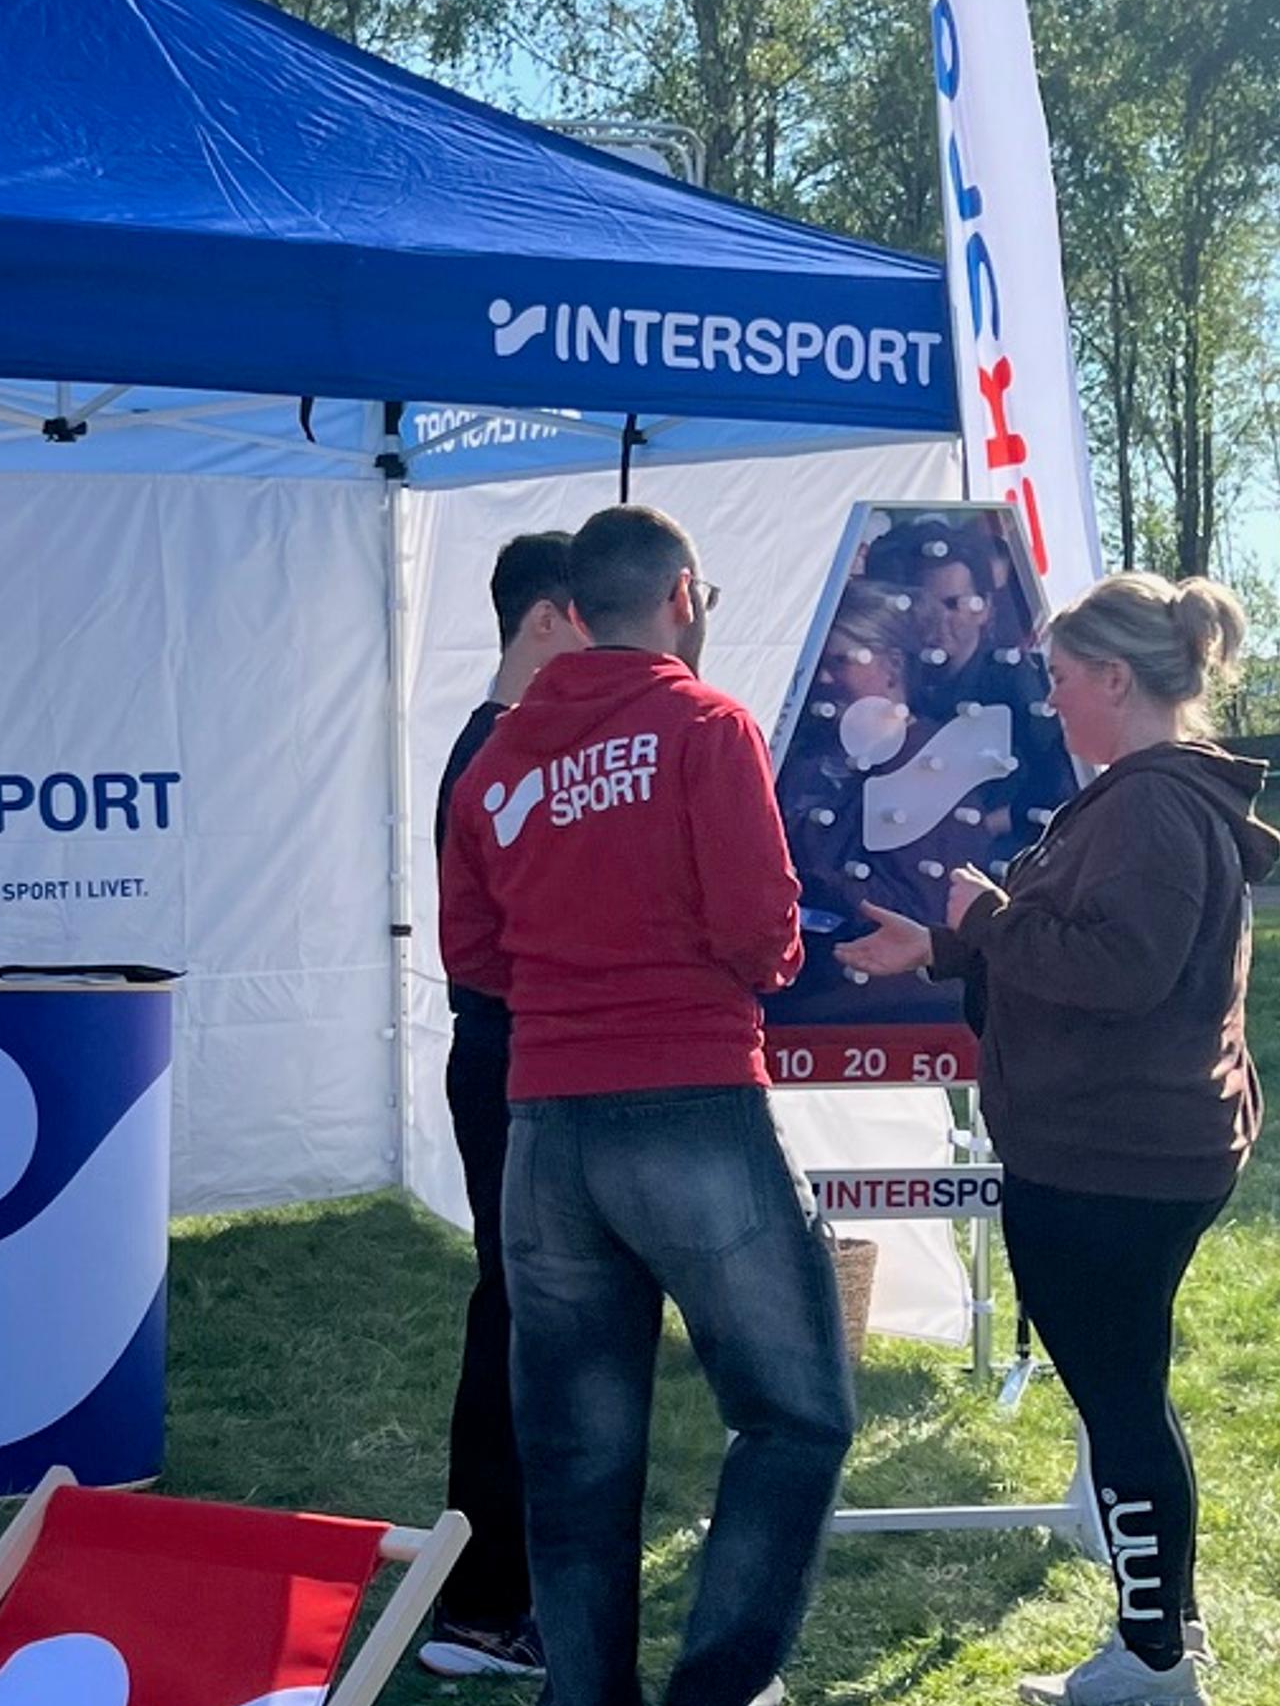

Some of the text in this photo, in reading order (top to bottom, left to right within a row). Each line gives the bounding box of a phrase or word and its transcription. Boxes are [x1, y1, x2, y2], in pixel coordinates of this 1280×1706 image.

[555, 304, 942, 386] INTERSPORT
[551, 733, 658, 791] INTER
[550, 766, 657, 827] SPORT
[2, 880, 69, 902] SPORT
[75, 880, 81, 898] I
[87, 878, 148, 899] LIVET.
[776, 1048, 958, 1082] 10 20 50
[826, 1178, 1003, 1210] INTERSPO
